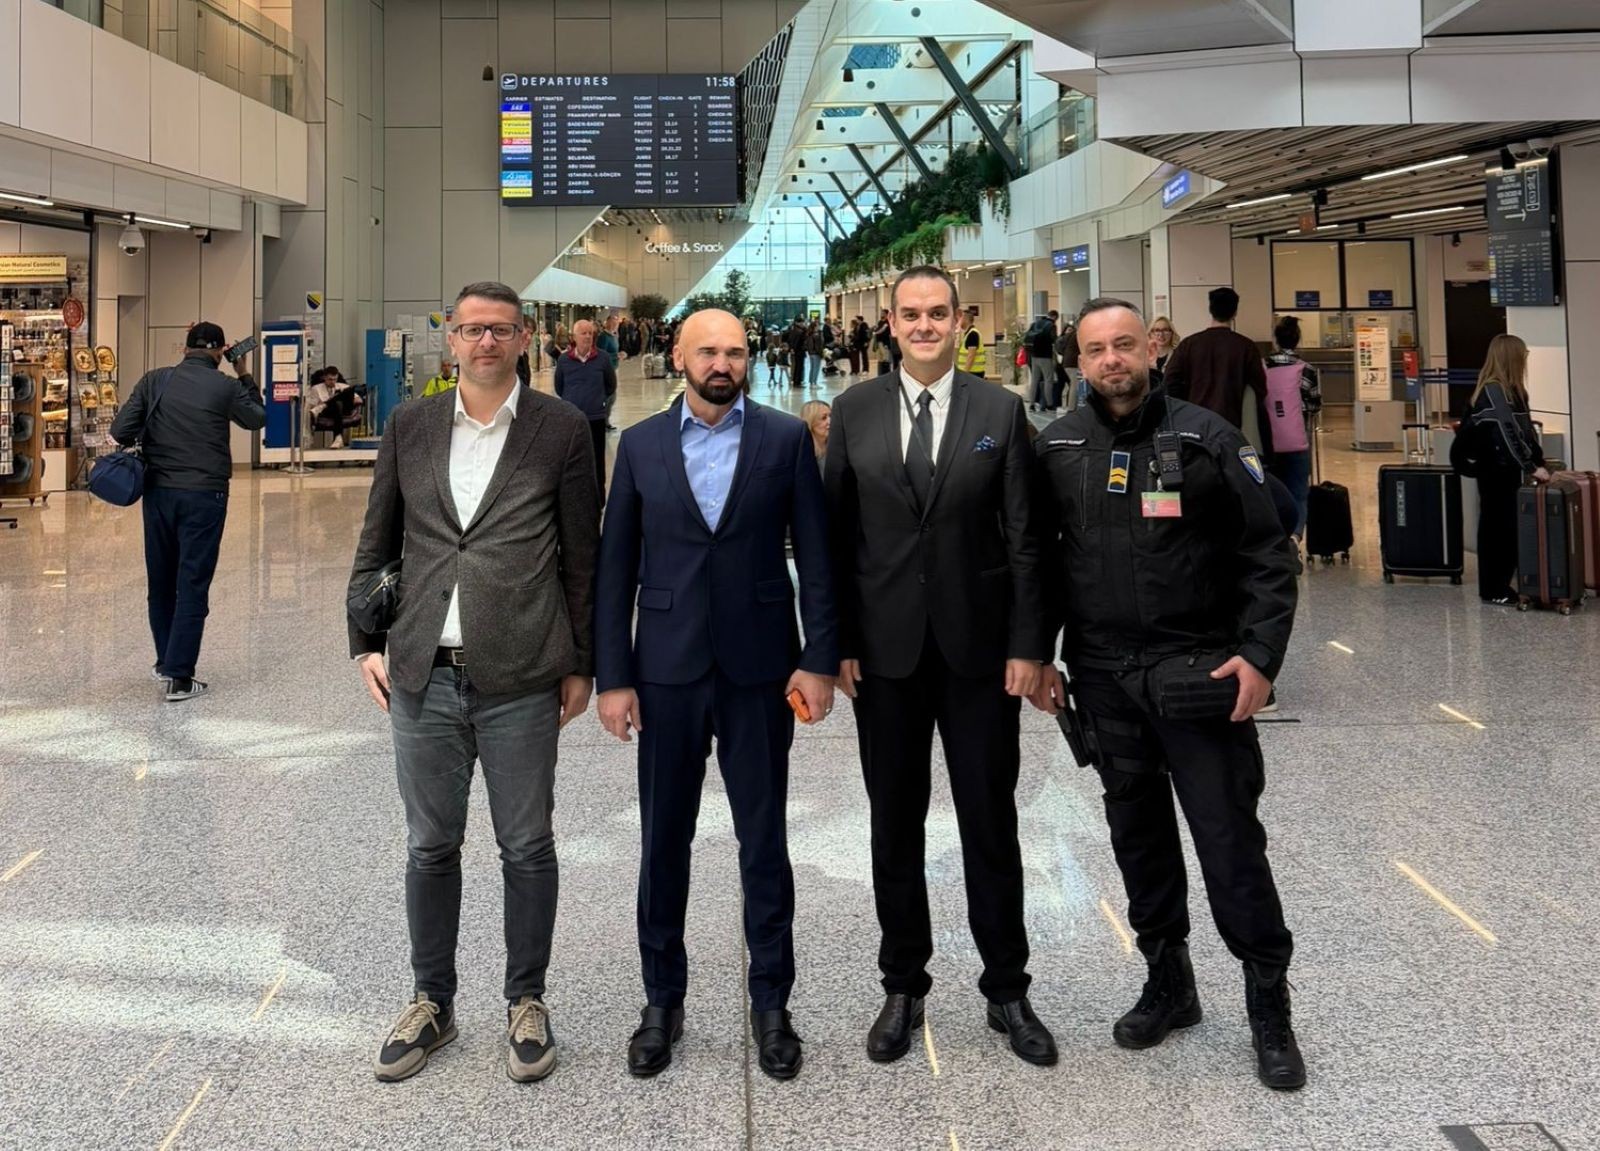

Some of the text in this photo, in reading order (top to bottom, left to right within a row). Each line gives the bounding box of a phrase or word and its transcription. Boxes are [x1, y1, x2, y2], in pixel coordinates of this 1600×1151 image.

[521, 76, 609, 86] DEPARTURES
[705, 76, 735, 87] 11:58
[645, 241, 724, 253] Coffee & Snack
